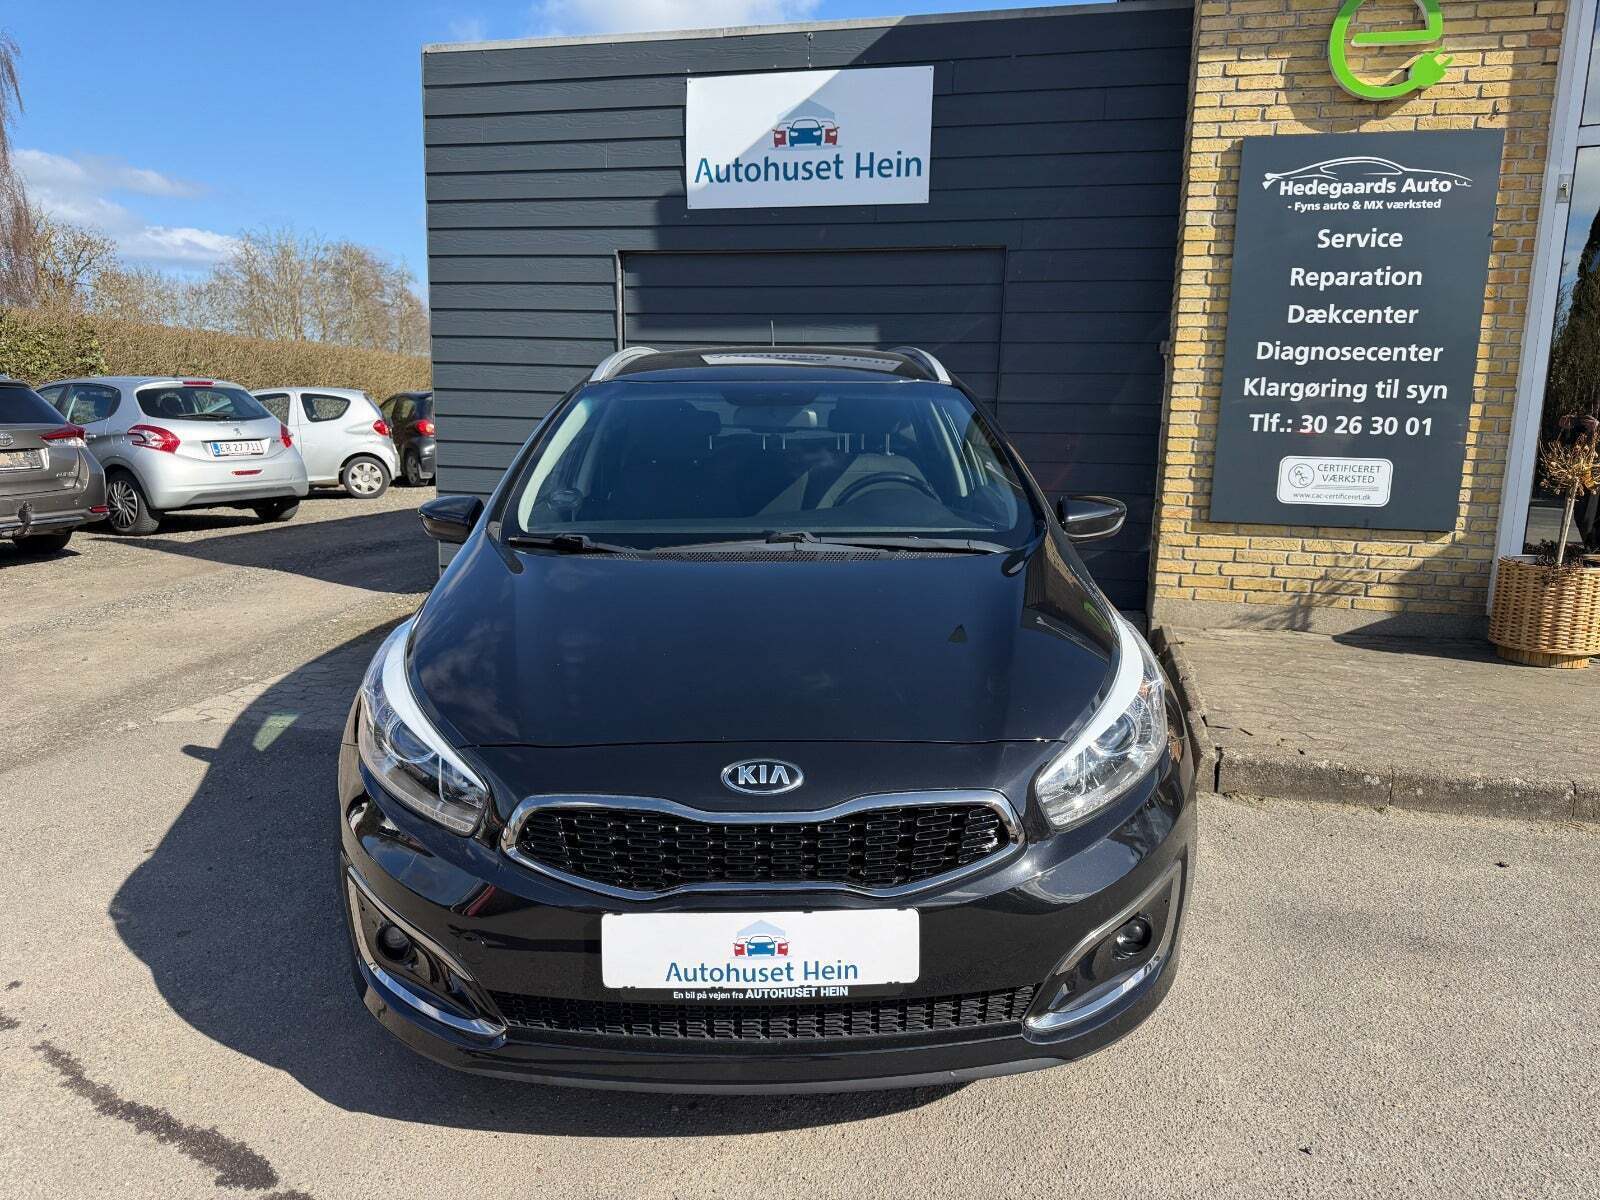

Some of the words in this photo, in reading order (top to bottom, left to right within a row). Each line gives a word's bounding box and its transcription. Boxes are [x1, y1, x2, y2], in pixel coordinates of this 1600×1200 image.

[695, 152, 844, 183] Autohuset
[855, 151, 922, 179] Hein
[1279, 178, 1396, 199] Hedegaards
[1401, 178, 1452, 194] Auto
[1294, 202, 1321, 213] Fyns
[1322, 202, 1350, 211] auto
[1352, 200, 1361, 210] &
[1363, 200, 1384, 210] MX
[1387, 199, 1442, 209] værksted
[1317, 228, 1404, 249] Service
[1290, 266, 1423, 291] Reparation
[1287, 304, 1419, 325] Dækcenter
[1256, 341, 1444, 366] Diagnosecenter
[1243, 377, 1368, 403] Klargøring
[1375, 379, 1400, 399] til
[1406, 382, 1449, 404] syn
[1249, 414, 1293, 433] Tlf.:
[1300, 415, 1328, 434] 30
[1334, 416, 1363, 435] 26
[1369, 417, 1399, 435] 30
[1405, 417, 1433, 436] 01
[1317, 463, 1382, 474] CERTIFICERET
[1321, 474, 1376, 484] VÆRKSTED
[1293, 492, 1371, 501] www.cac-certificeret.dk
[737, 765, 791, 785] KIA
[665, 961, 795, 983] Autohuset
[803, 959, 858, 981] Hein
[673, 991, 684, 999] En
[685, 991, 696, 999] bil
[697, 990, 708, 1001] på
[708, 991, 731, 1001] vejen
[732, 991, 744, 999] fra
[745, 986, 818, 999] AUTOHUSET
[820, 986, 849, 997] HEIN
